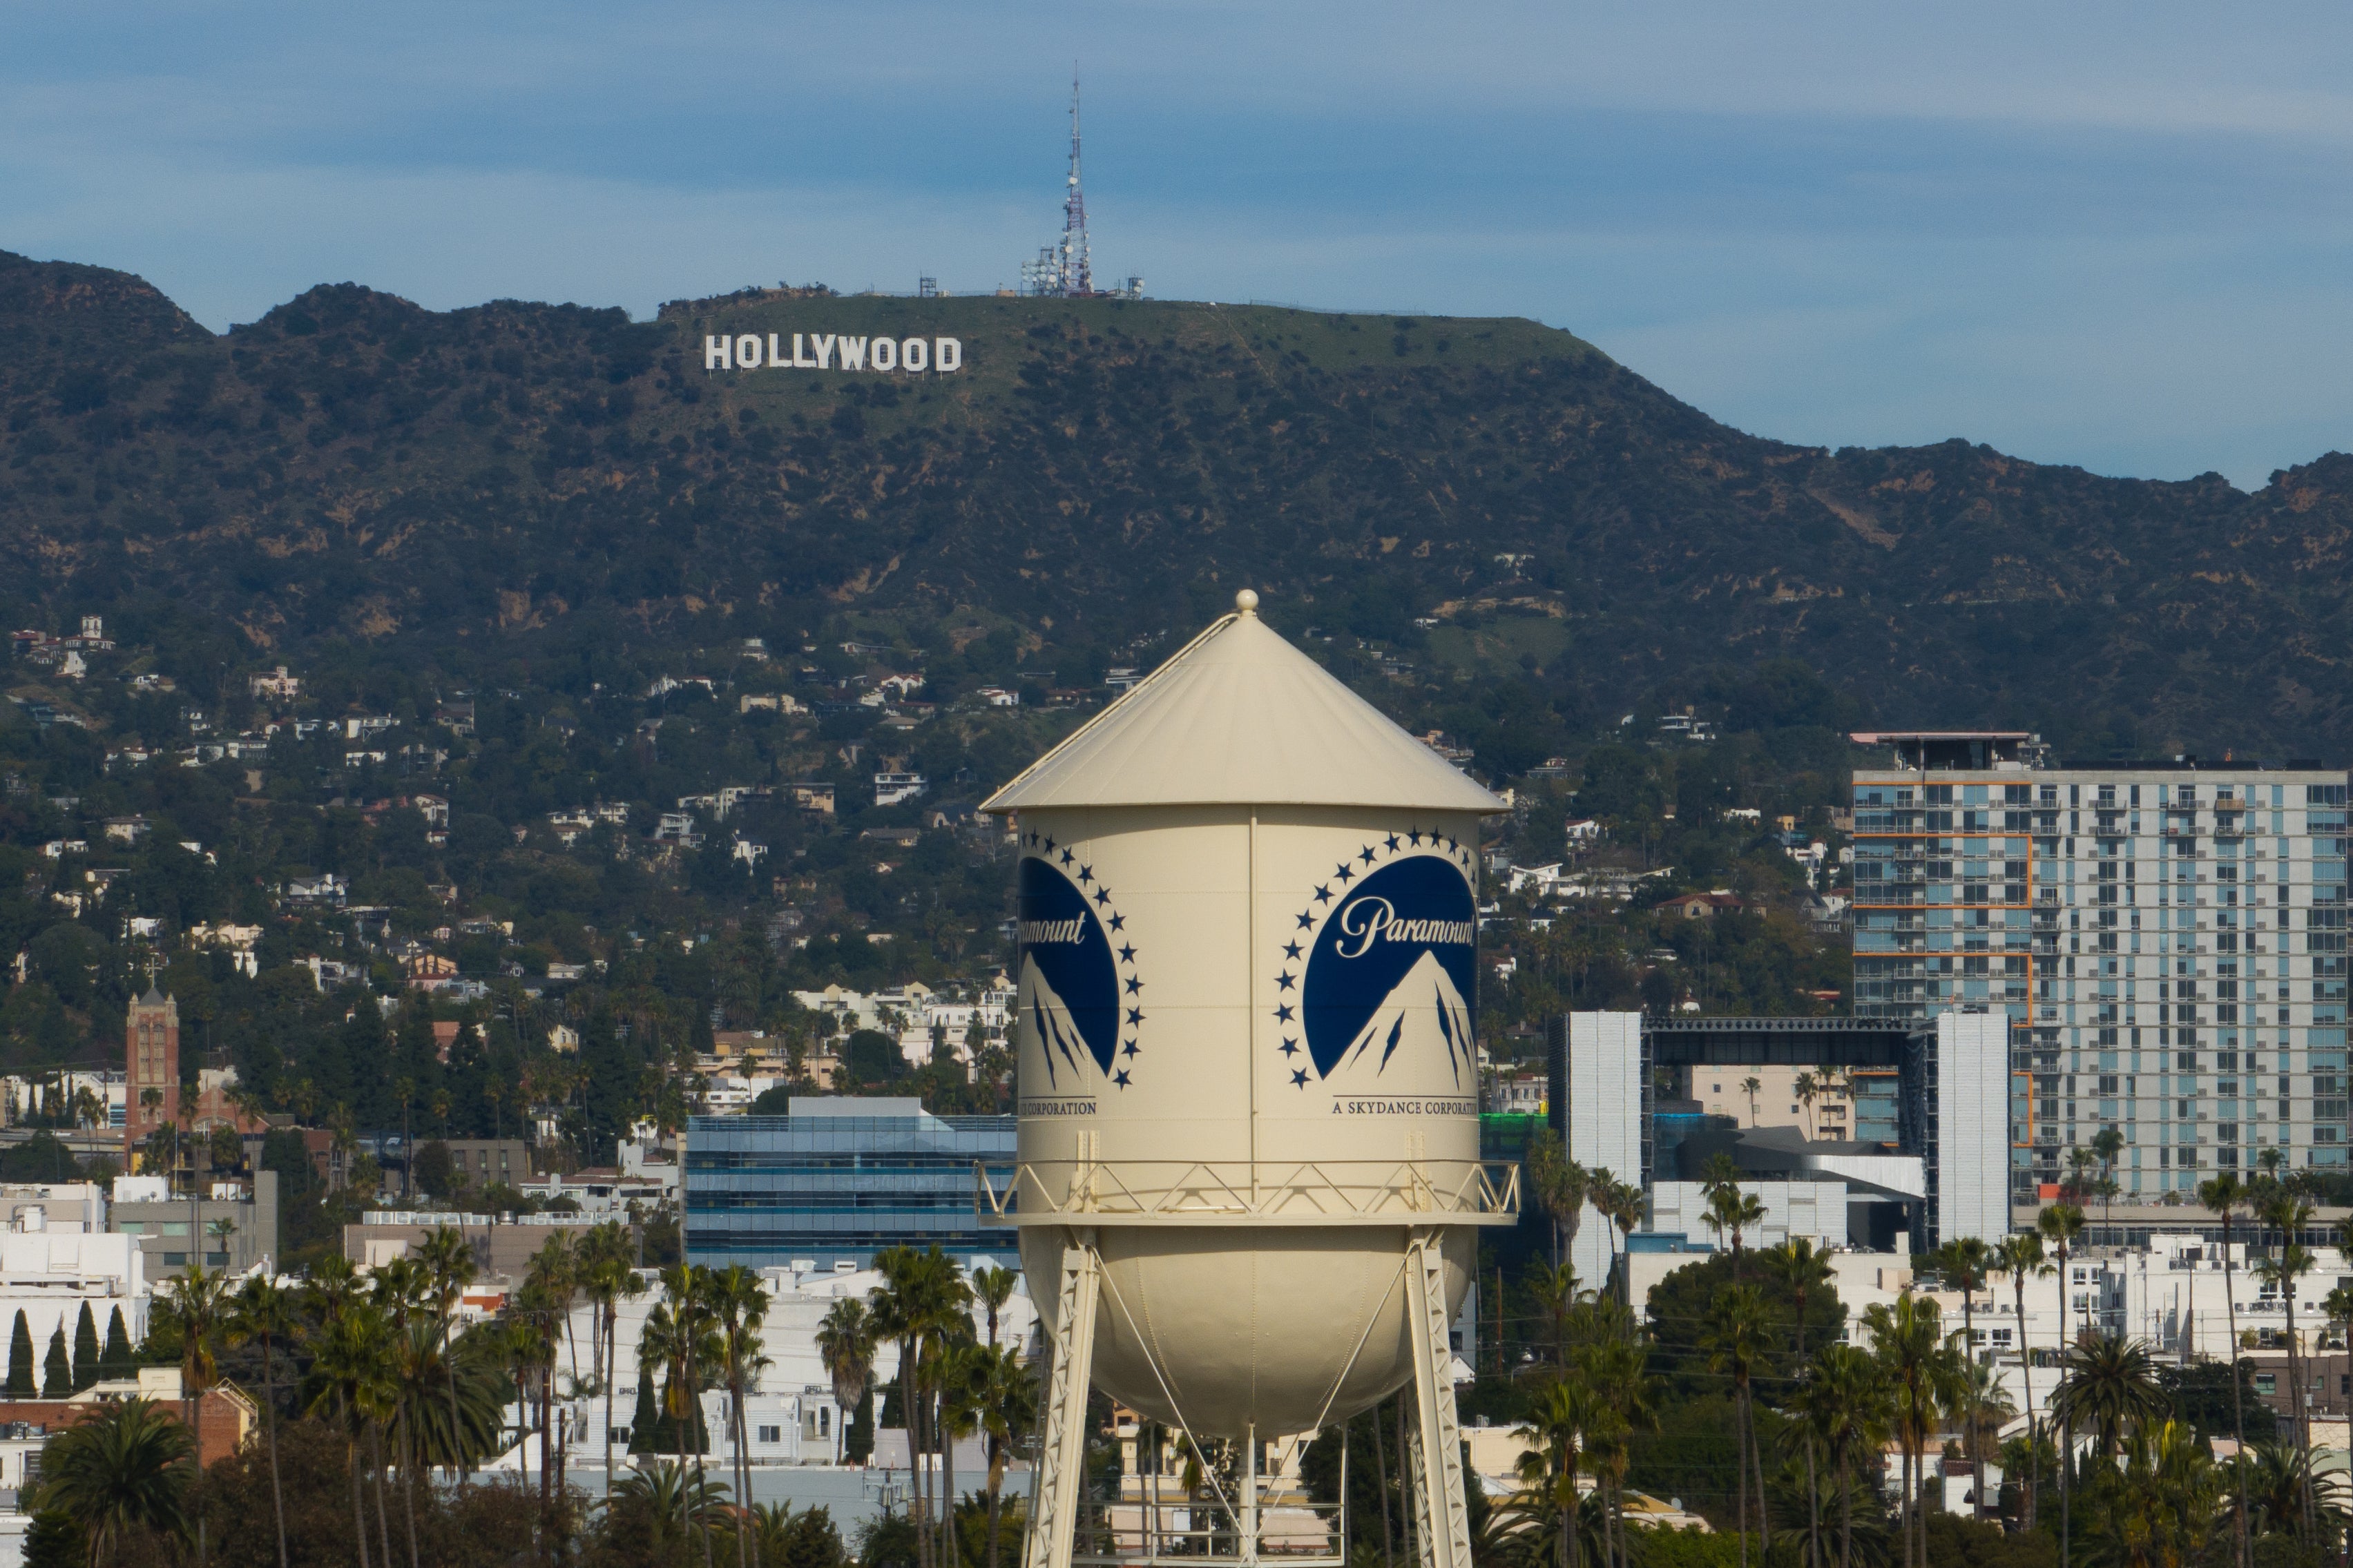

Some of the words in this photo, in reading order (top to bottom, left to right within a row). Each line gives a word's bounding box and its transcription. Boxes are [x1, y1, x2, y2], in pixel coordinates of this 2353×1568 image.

[706, 333, 961, 371] HOLLYWOOD
[1336, 896, 1475, 958] Paramount
[1028, 1102, 1097, 1116] CORPORATION
[1332, 1102, 1343, 1114] A
[1348, 1102, 1421, 1114] SKYDANCE
